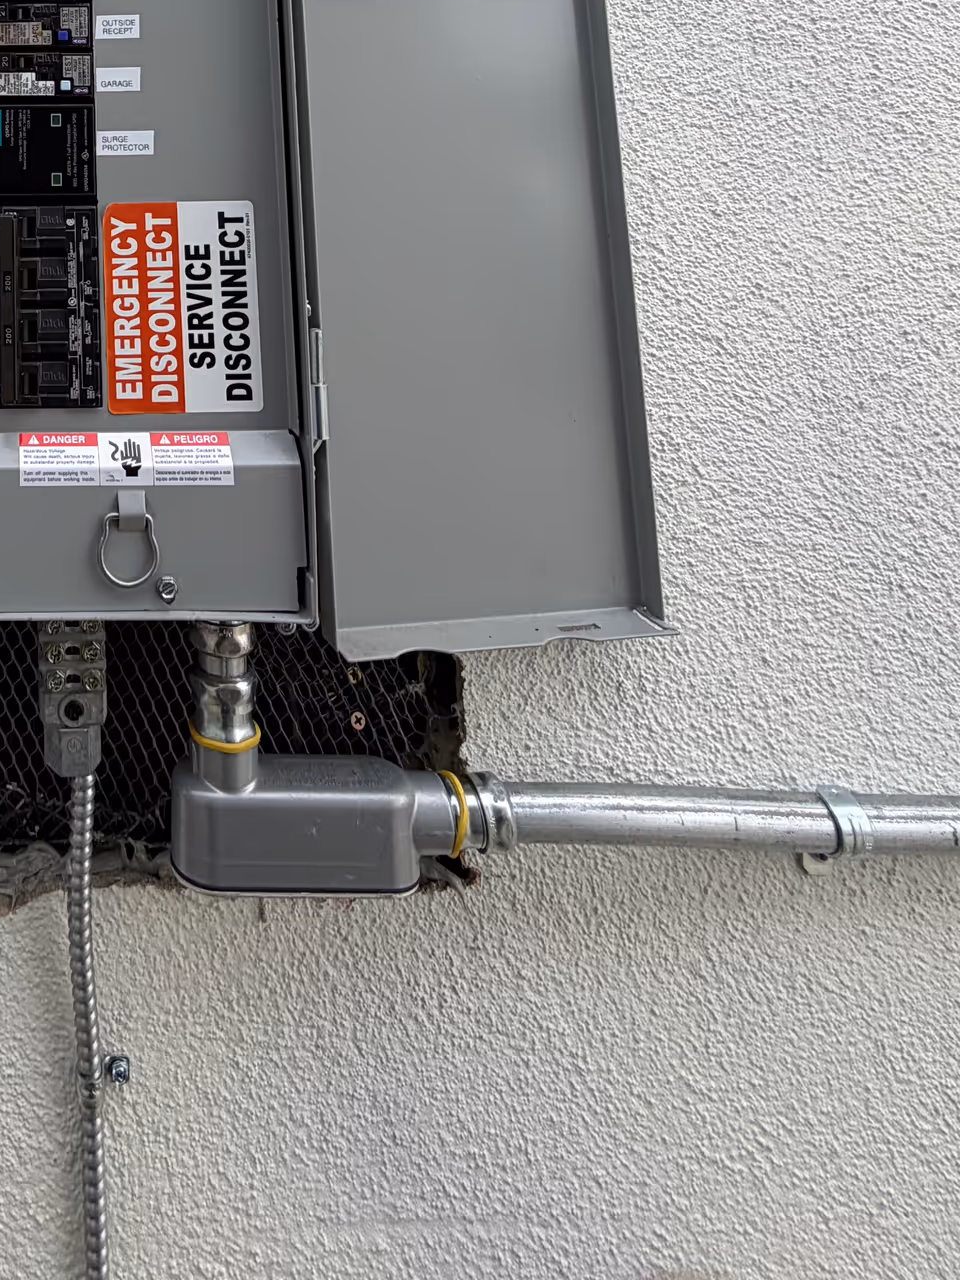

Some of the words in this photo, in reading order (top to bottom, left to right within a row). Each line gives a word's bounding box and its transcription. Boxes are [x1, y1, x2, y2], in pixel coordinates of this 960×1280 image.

[2, 56, 8, 67] 20
[110, 216, 143, 400] EMERGENCY
[145, 212, 179, 403] DISCONNECT
[184, 244, 216, 370] SERVICE
[217, 211, 253, 401] DISCONNECT
[43, 436, 85, 444] DANGER
[174, 435, 218, 444] PELIGRO
